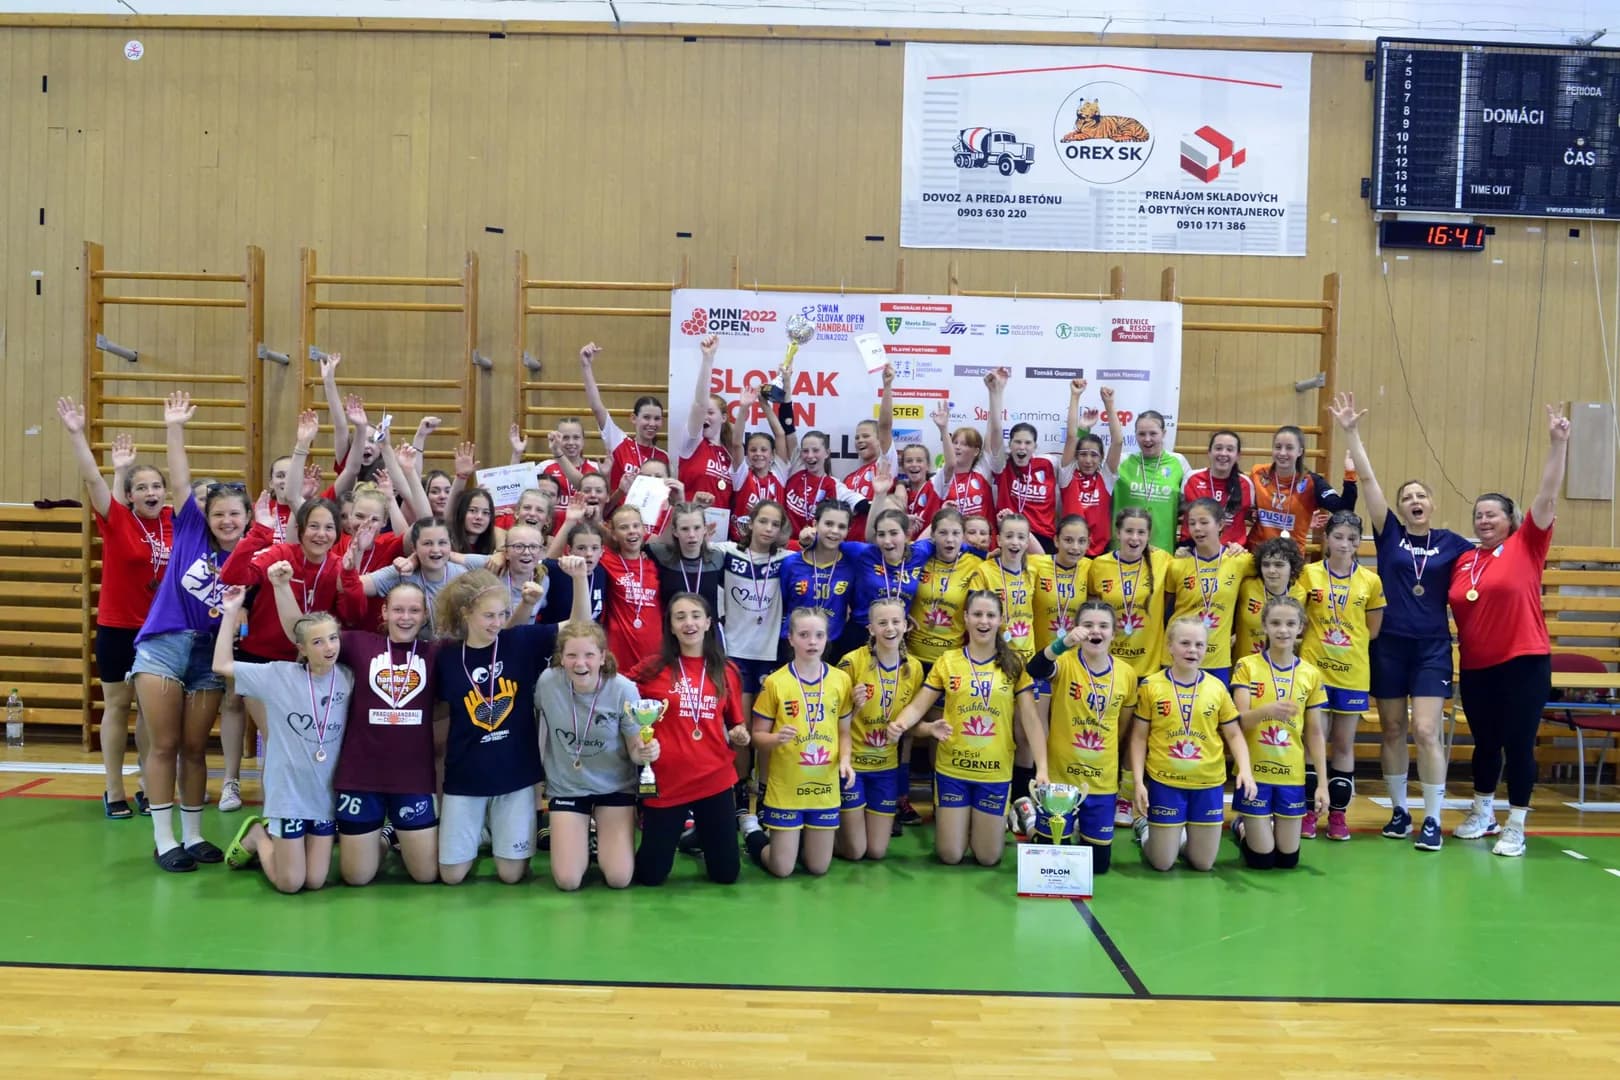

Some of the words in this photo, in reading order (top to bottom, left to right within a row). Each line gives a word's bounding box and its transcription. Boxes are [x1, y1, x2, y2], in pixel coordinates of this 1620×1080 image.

[1405, 54, 1412, 63] 4
[1405, 68, 1412, 76] 5
[1404, 80, 1412, 90] 6
[1404, 94, 1411, 102] 7
[1404, 106, 1410, 115] 8
[1484, 106, 1544, 124] DOMÁCI
[1403, 120, 1410, 128] 9
[1396, 132, 1408, 142] 10
[1066, 146, 1115, 160] OREX
[1118, 146, 1142, 161] SK
[1396, 146, 1408, 154] 11
[1396, 158, 1408, 167] 12
[1564, 148, 1596, 166] ČAS
[1395, 171, 1408, 180] 13
[1394, 184, 1407, 193] 14
[1470, 184, 1490, 194] TIME
[1493, 186, 1511, 195] OUT
[922, 192, 962, 203] DOVOZ
[966, 194, 974, 203] A
[976, 194, 1016, 205] PREDAJ
[1018, 192, 1062, 204] BETÓNU
[1145, 188, 1204, 203] PRENÁJOM
[1206, 189, 1278, 202] SKLADOVÝCH
[1394, 197, 1406, 206] 15
[958, 208, 984, 218] 0903
[986, 208, 1005, 218] 630
[1007, 208, 1028, 218] 220
[1138, 205, 1147, 214] A
[1149, 202, 1206, 216] OBYTNÝCH
[1207, 206, 1285, 218] KONTAJNEROV
[1176, 220, 1202, 230] 0910
[1204, 221, 1224, 231] 171
[1226, 222, 1246, 231] 386
[1427, 226, 1483, 245] 16:41
[816, 304, 838, 313] SWAN
[709, 308, 742, 320] MINI
[742, 310, 776, 322] 2022
[816, 314, 844, 322] SLOVAK
[846, 314, 864, 323] OPEN
[708, 320, 750, 332] OPEN
[816, 322, 854, 332] HANDBALL
[496, 483, 520, 492] DIPLOM
[1216, 490, 1222, 502] 8
[730, 559, 748, 574] 53
[1124, 580, 1132, 596] 8
[970, 680, 990, 698] 58
[952, 758, 1000, 770] CORNER
[1066, 766, 1100, 778] DS-CAR
[1253, 764, 1290, 776] DS-CAR
[796, 786, 832, 796] DS-CAR
[336, 794, 362, 814] 76
